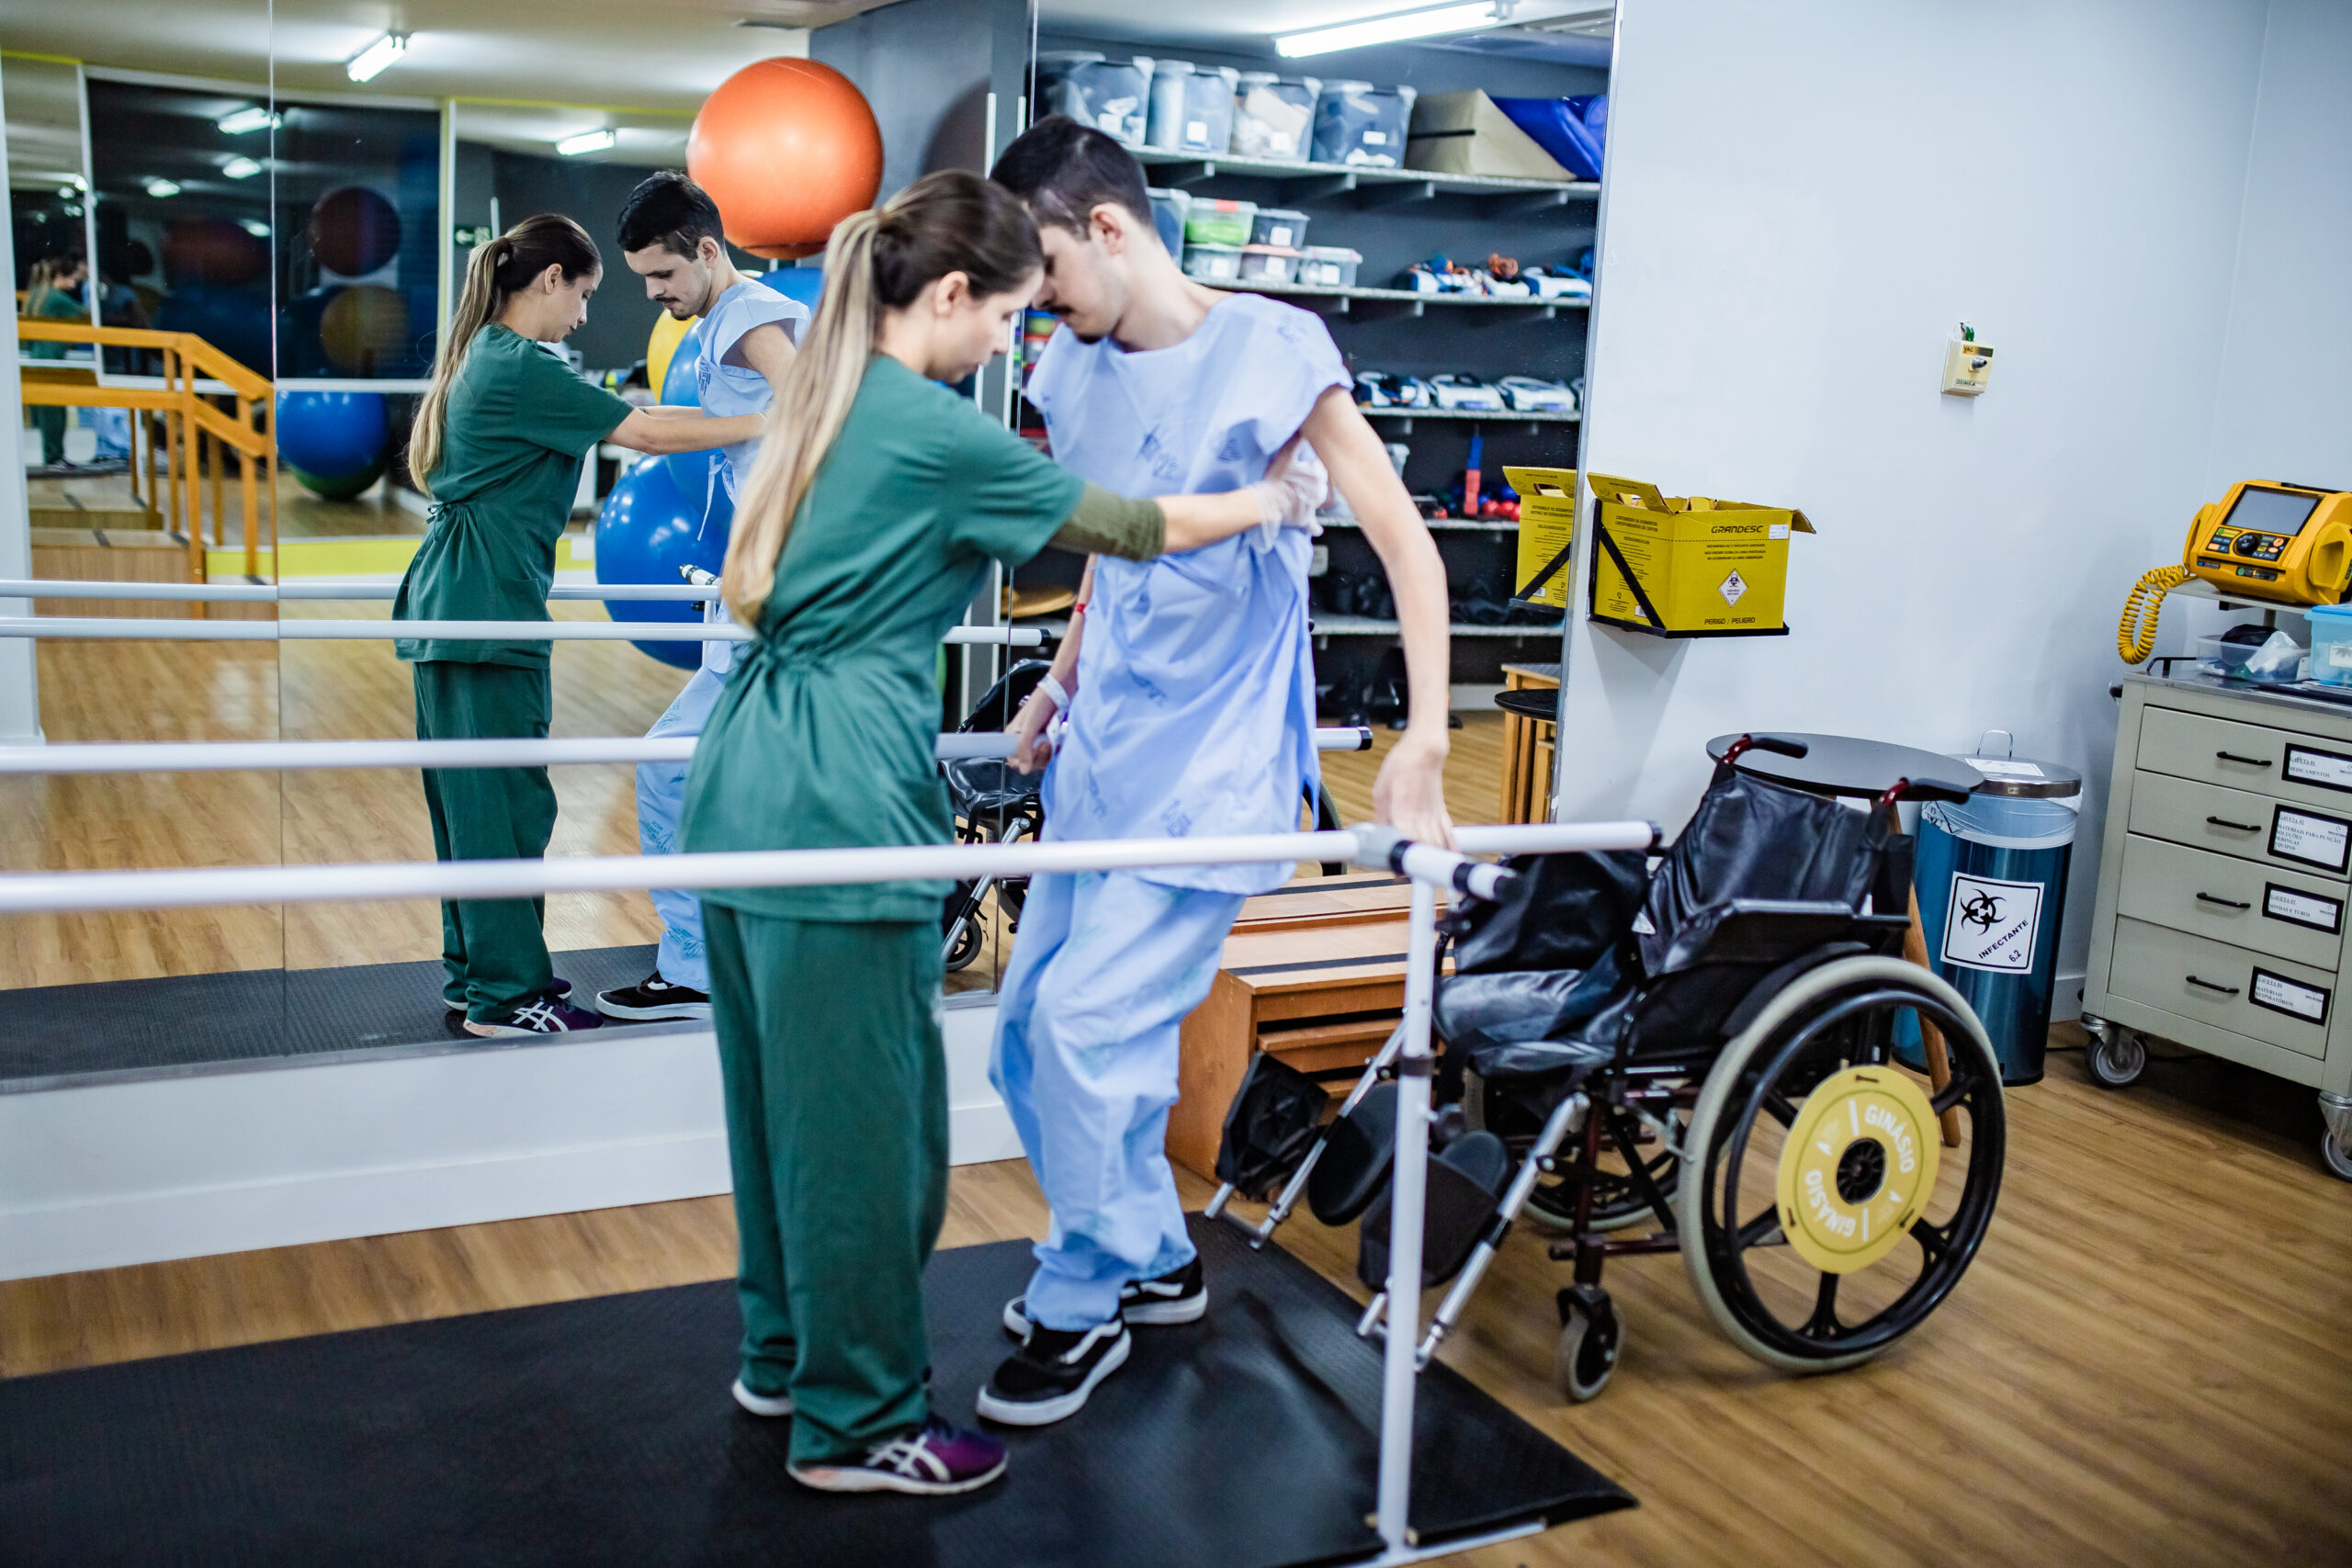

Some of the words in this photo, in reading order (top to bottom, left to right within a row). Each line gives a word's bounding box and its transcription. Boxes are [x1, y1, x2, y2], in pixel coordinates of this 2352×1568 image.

[1711, 525, 1764, 534] GRANDESC
[2278, 823, 2304, 835] MATERIAIS
[2319, 834, 2342, 844] PUNÇÃO
[1978, 919, 2029, 959] INFECTANTE
[1864, 1103, 1916, 1174] GINÁSIO
[1804, 1168, 1857, 1238] GINÁSIO
